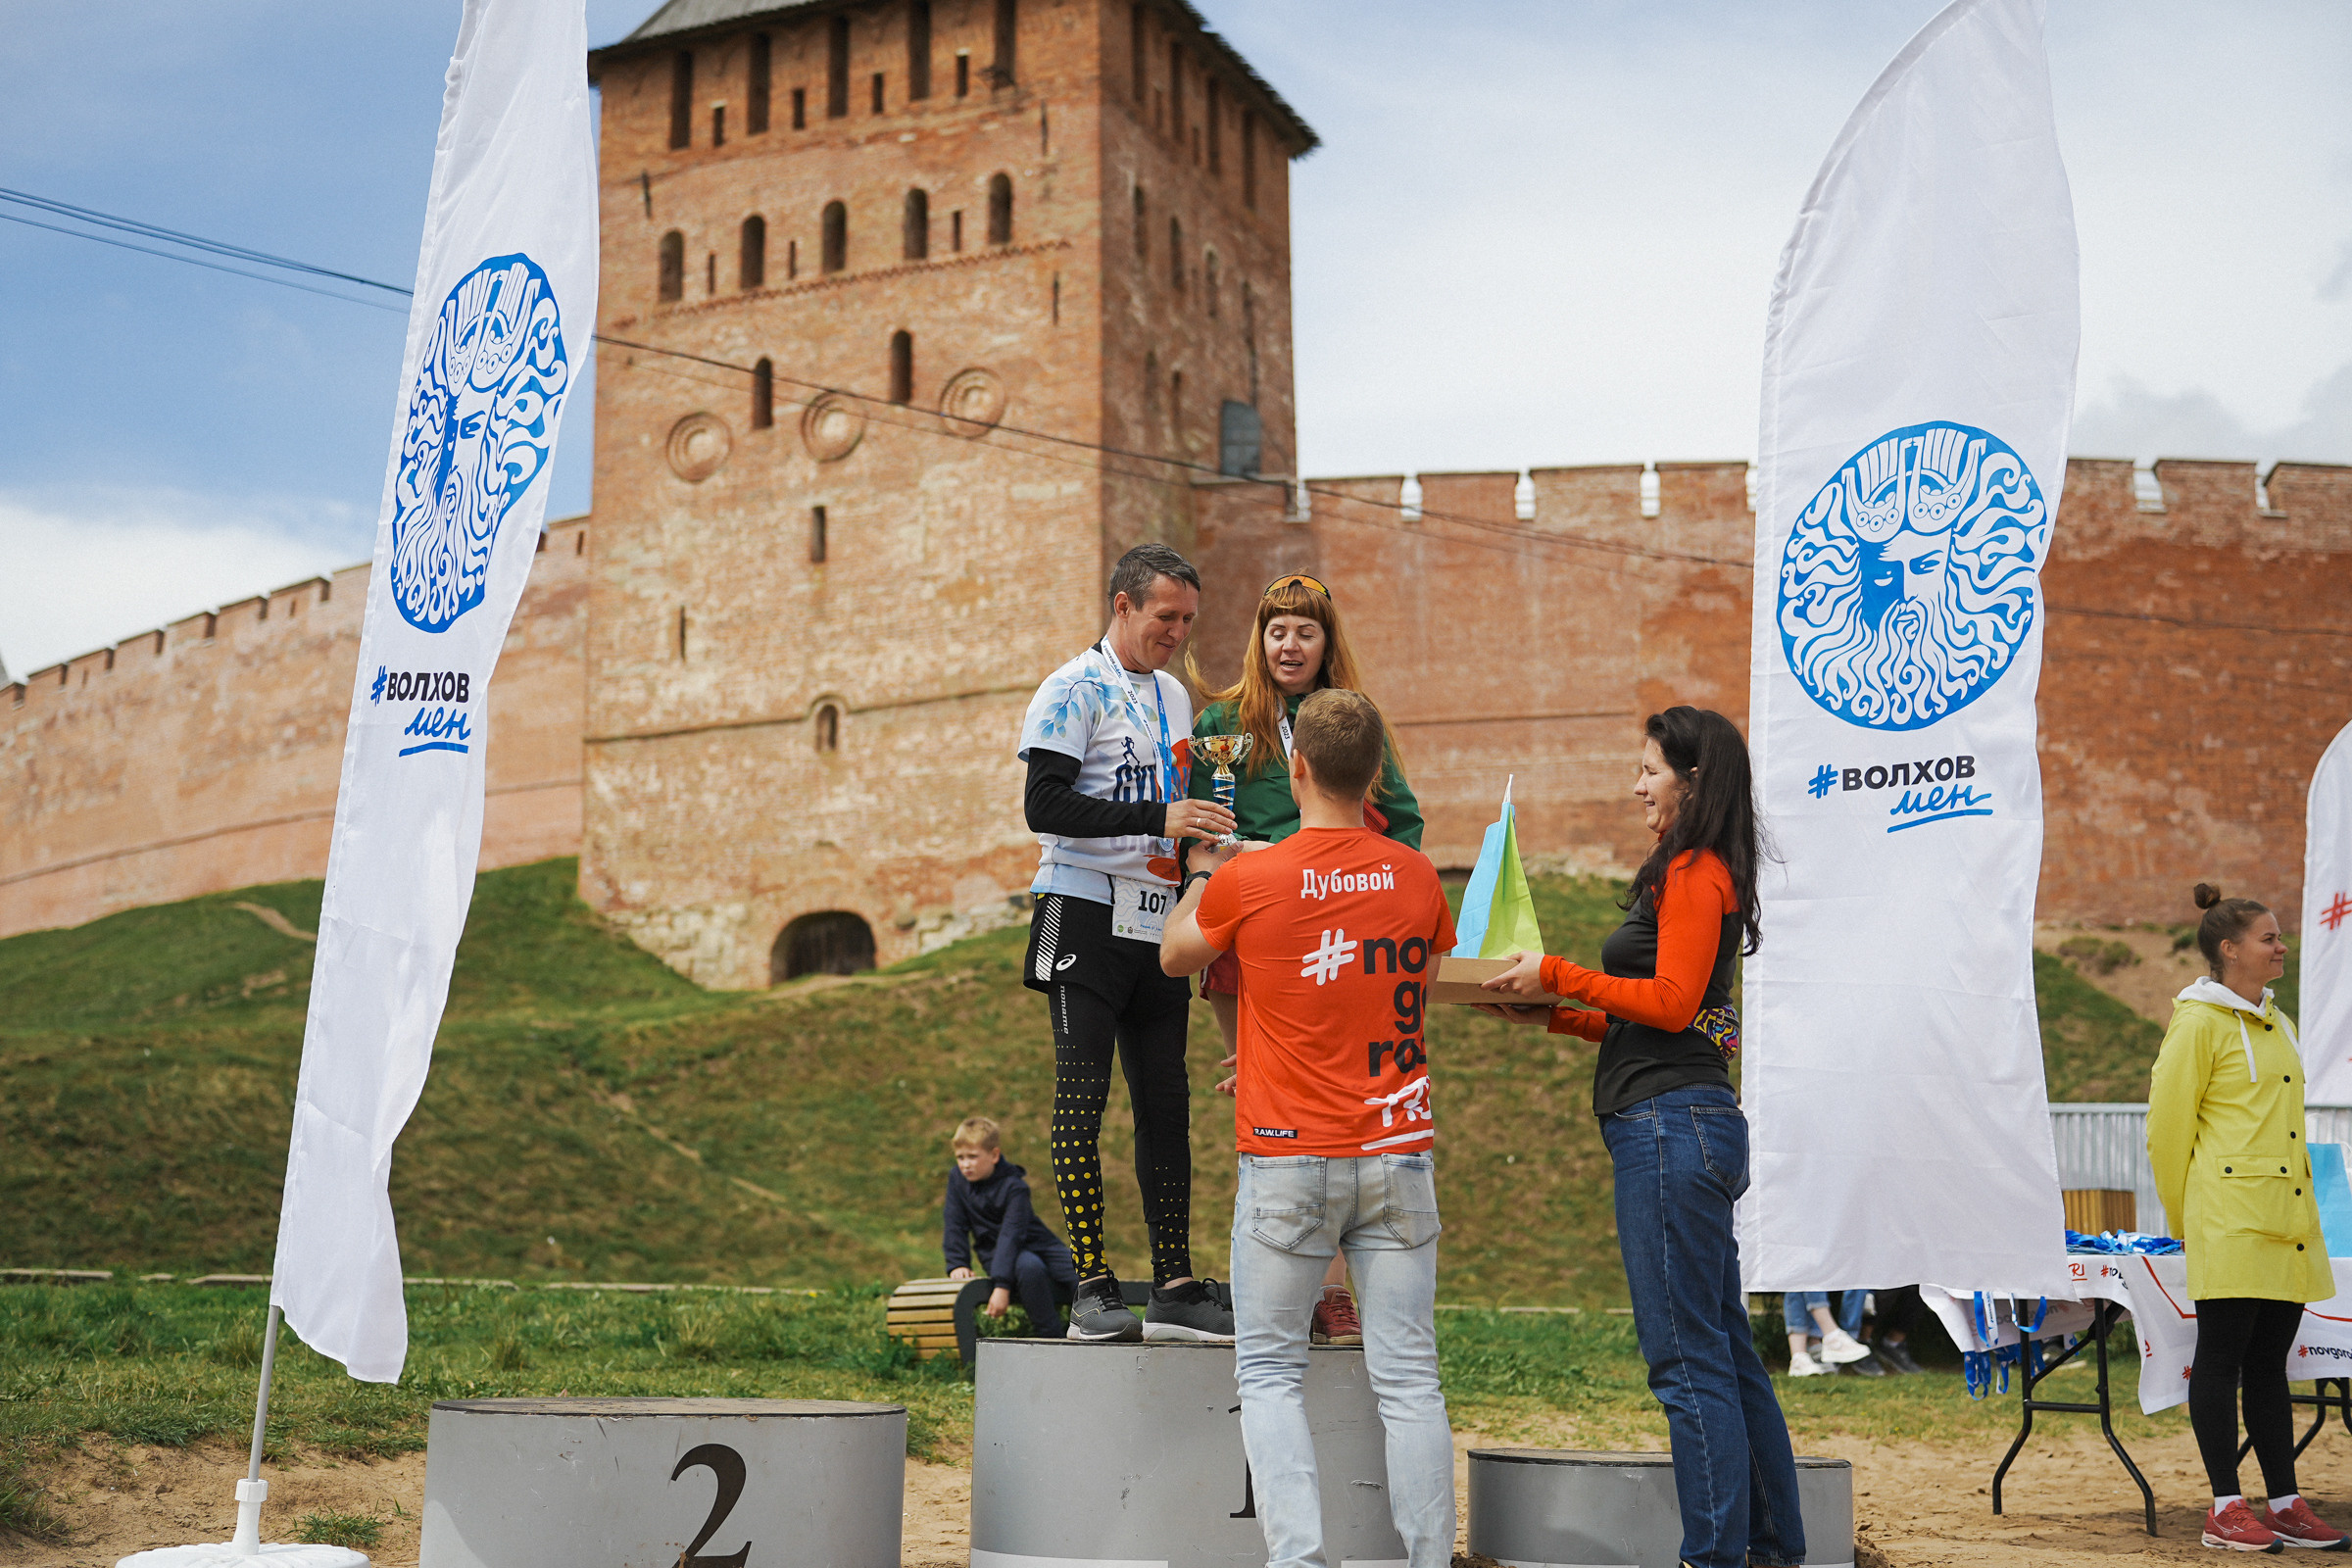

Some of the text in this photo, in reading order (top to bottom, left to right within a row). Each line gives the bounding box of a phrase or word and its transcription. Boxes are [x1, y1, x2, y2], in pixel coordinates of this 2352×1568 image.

[370, 665, 470, 707] #ВОЛХОВ
[1128, 690, 1138, 705] 2023
[1281, 725, 1291, 740] 2023
[1808, 756, 1976, 799] #ВОЛХОВ
[1138, 890, 1166, 915] 107
[1300, 864, 1395, 901] Дубовой
[1060, 984, 1069, 1035] noname
[1394, 980, 1427, 1035] g
[1368, 1037, 1427, 1078] ro
[2297, 1344, 2352, 1360] #novgoro
[670, 1443, 752, 1568] 2
